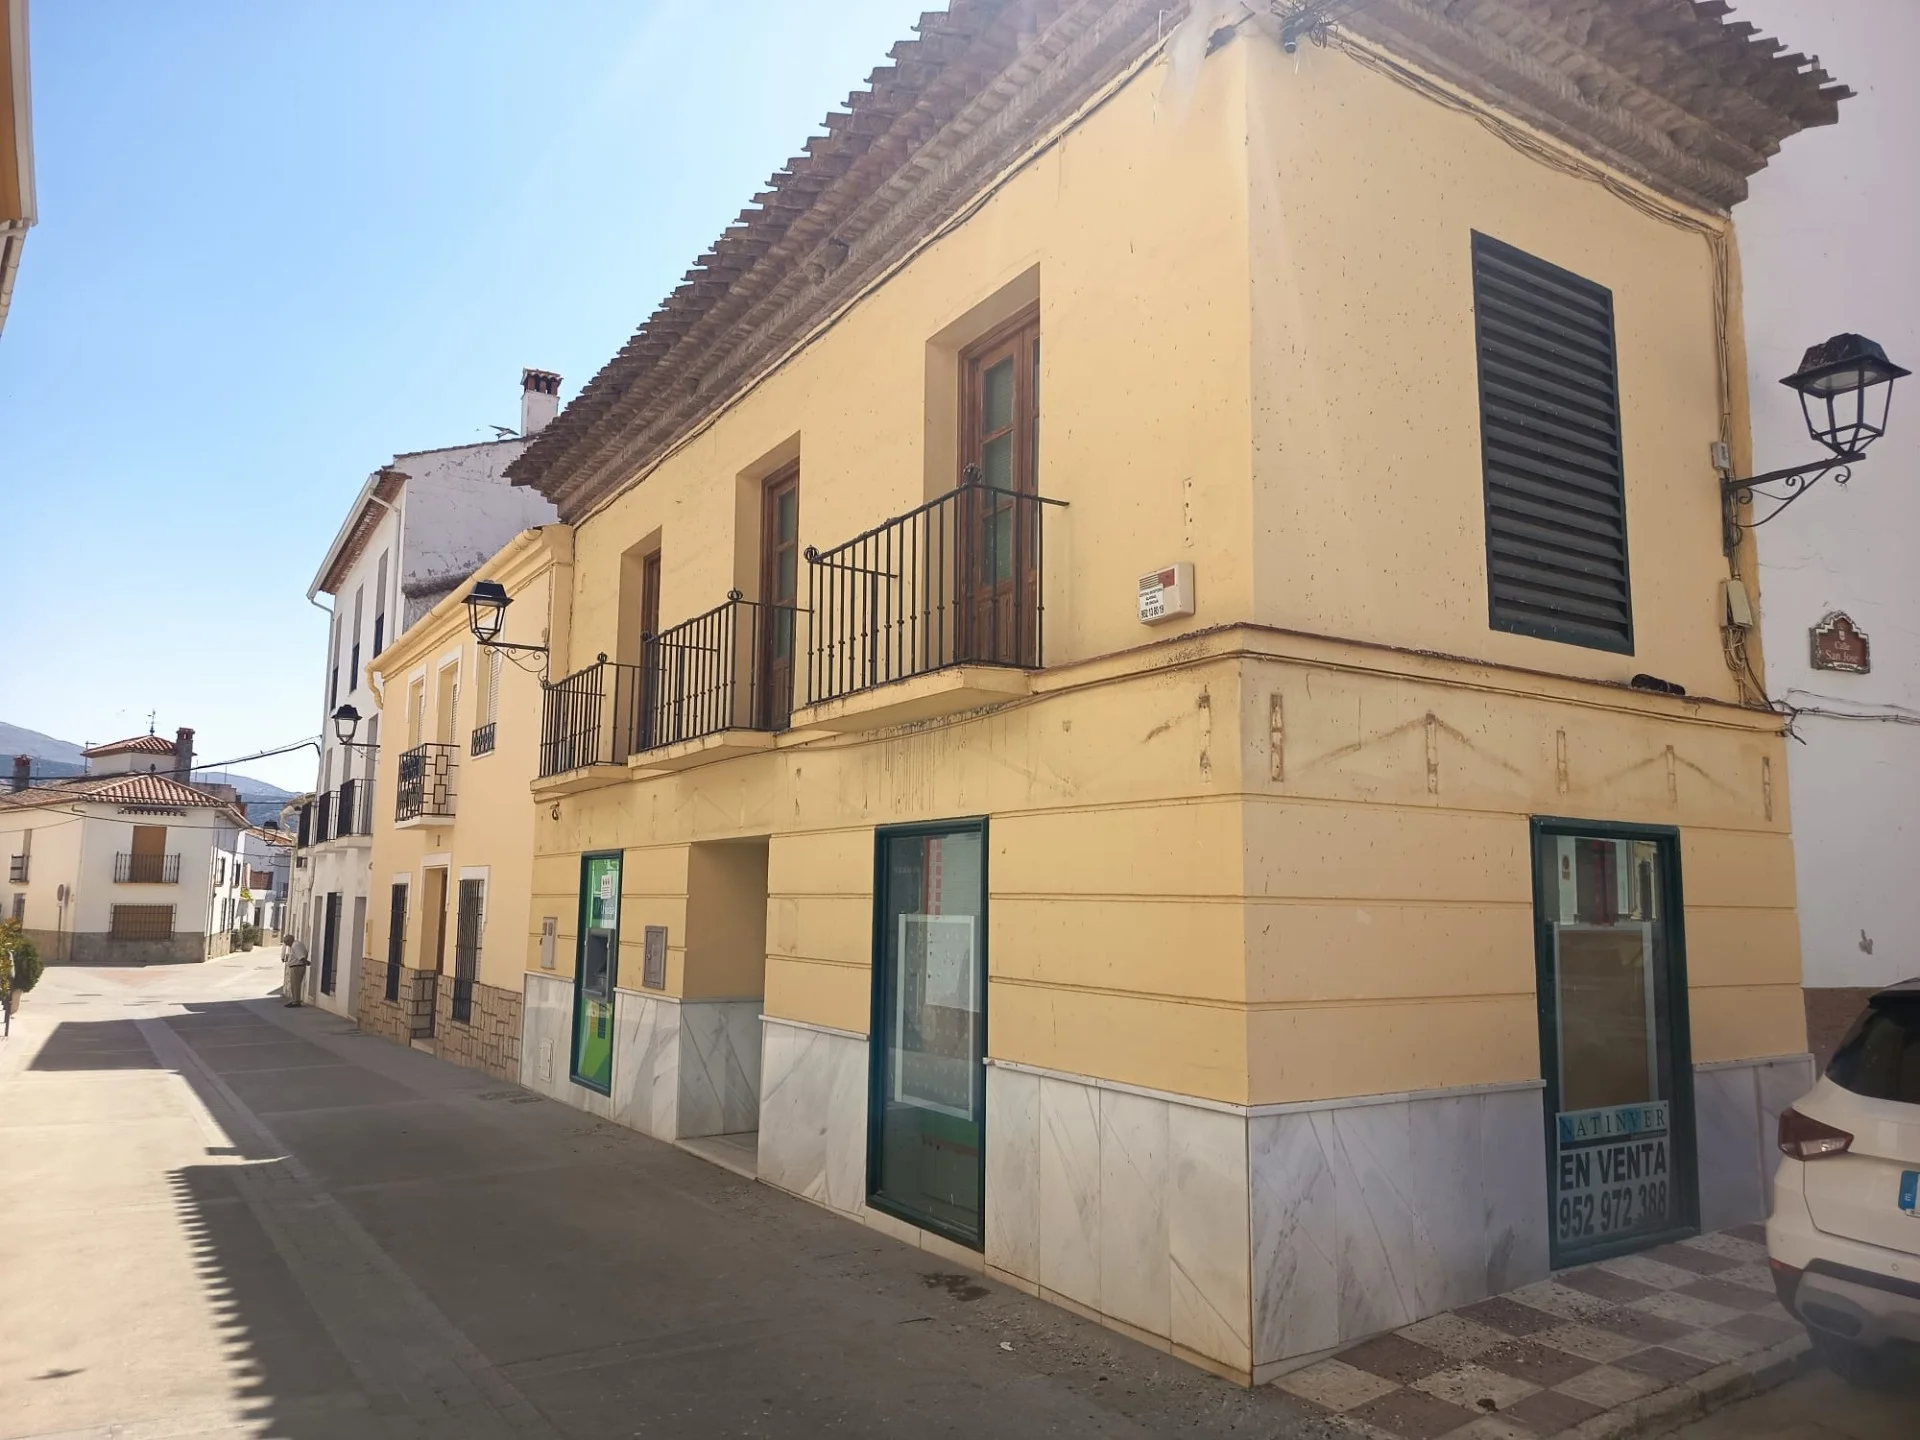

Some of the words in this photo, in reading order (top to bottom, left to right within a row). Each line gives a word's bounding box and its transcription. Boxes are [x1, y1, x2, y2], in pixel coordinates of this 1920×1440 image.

[1825, 649, 1840, 660] San
[1834, 641, 1851, 650] Calle
[1560, 1152, 1590, 1191] EN
[1597, 1141, 1666, 1184] VENTA
[1559, 1194, 1594, 1239] 952
[1600, 1187, 1632, 1231] 972
